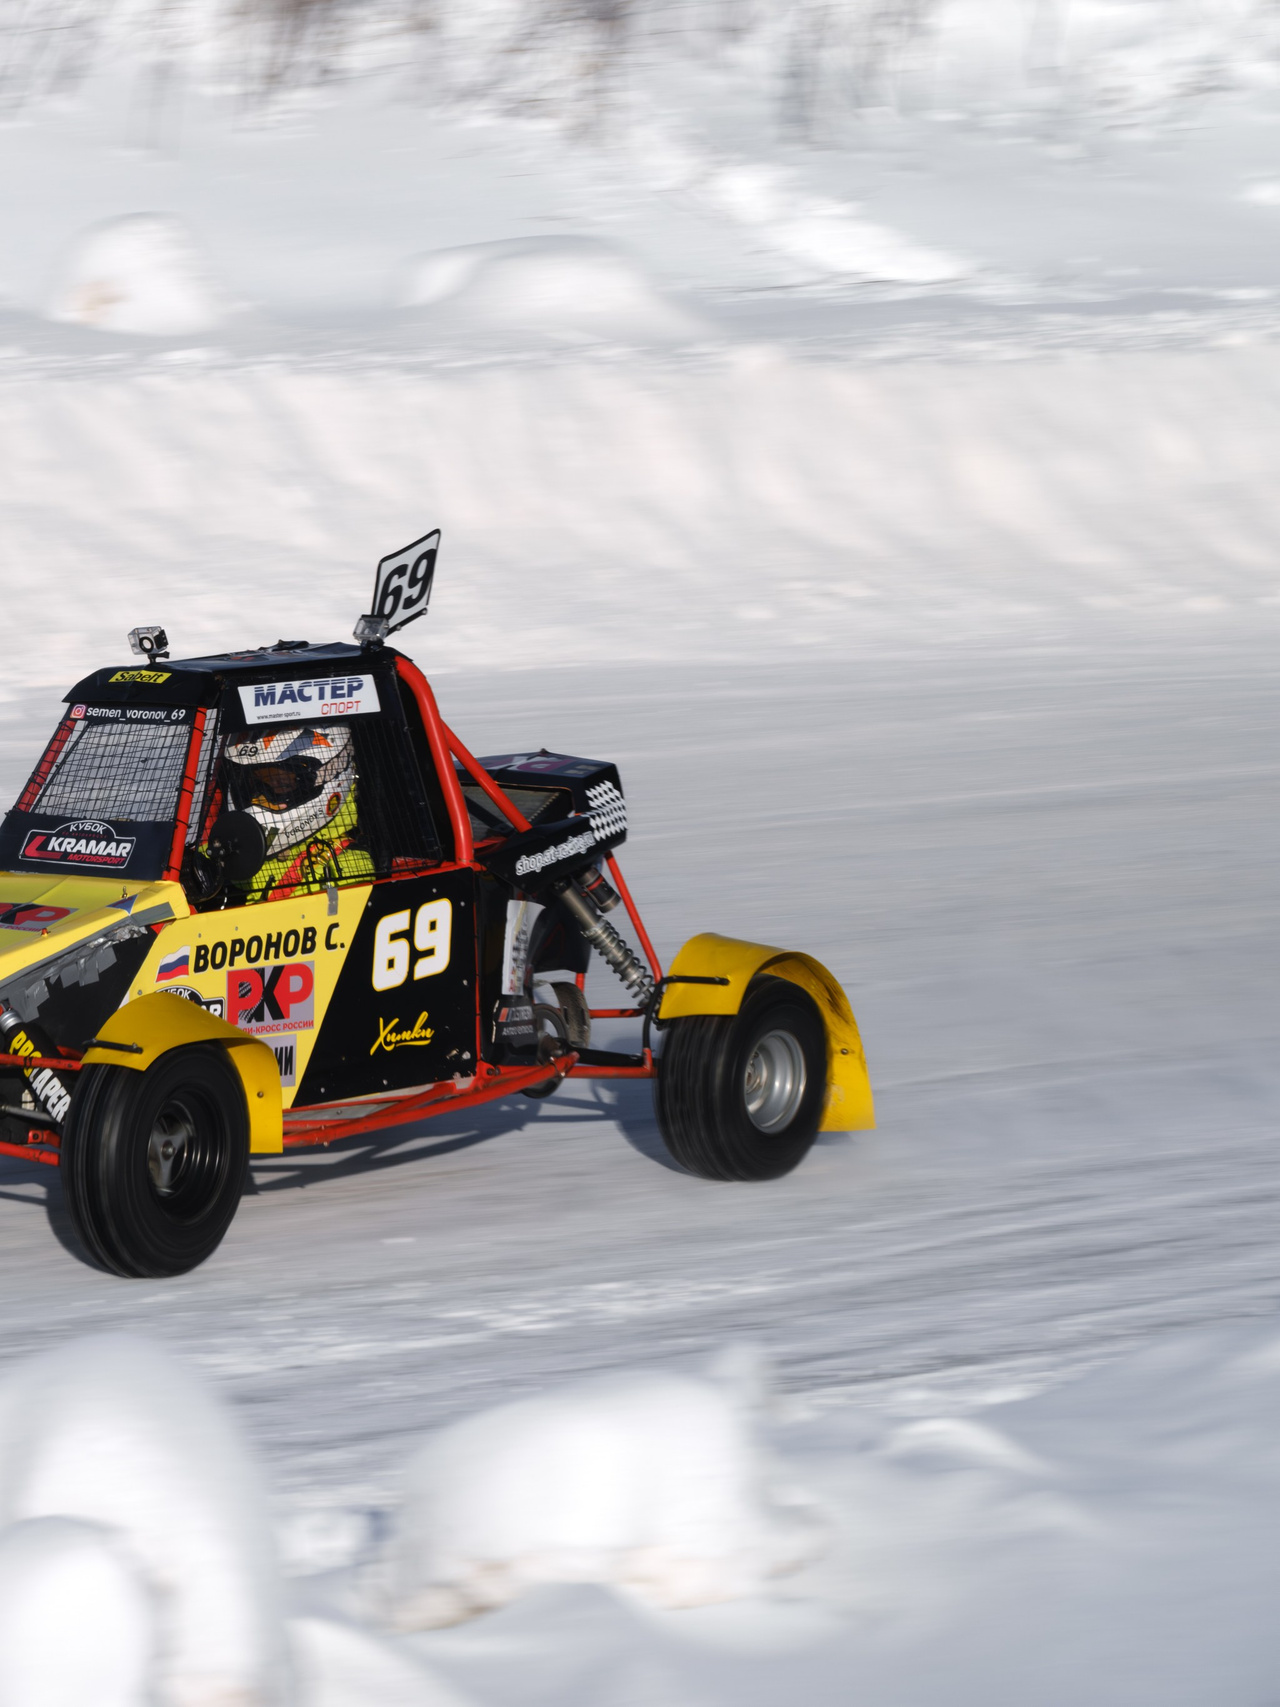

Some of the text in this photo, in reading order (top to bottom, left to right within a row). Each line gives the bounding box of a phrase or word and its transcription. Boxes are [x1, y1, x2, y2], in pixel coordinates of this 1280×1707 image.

[376, 548, 437, 621] 69
[254, 677, 364, 707] МАСТЕР
[86, 707, 186, 722] semen_voronov_69
[321, 701, 362, 715] СПОРТ
[239, 745, 258, 758] 69
[69, 822, 107, 834] КУБОК
[47, 836, 132, 857] KRAMAR
[67, 853, 126, 865] MOTORSPORT
[193, 922, 346, 974] ВОРОНОВ С.
[372, 898, 452, 992] 69
[283, 1020, 314, 1030] РОССИИ
